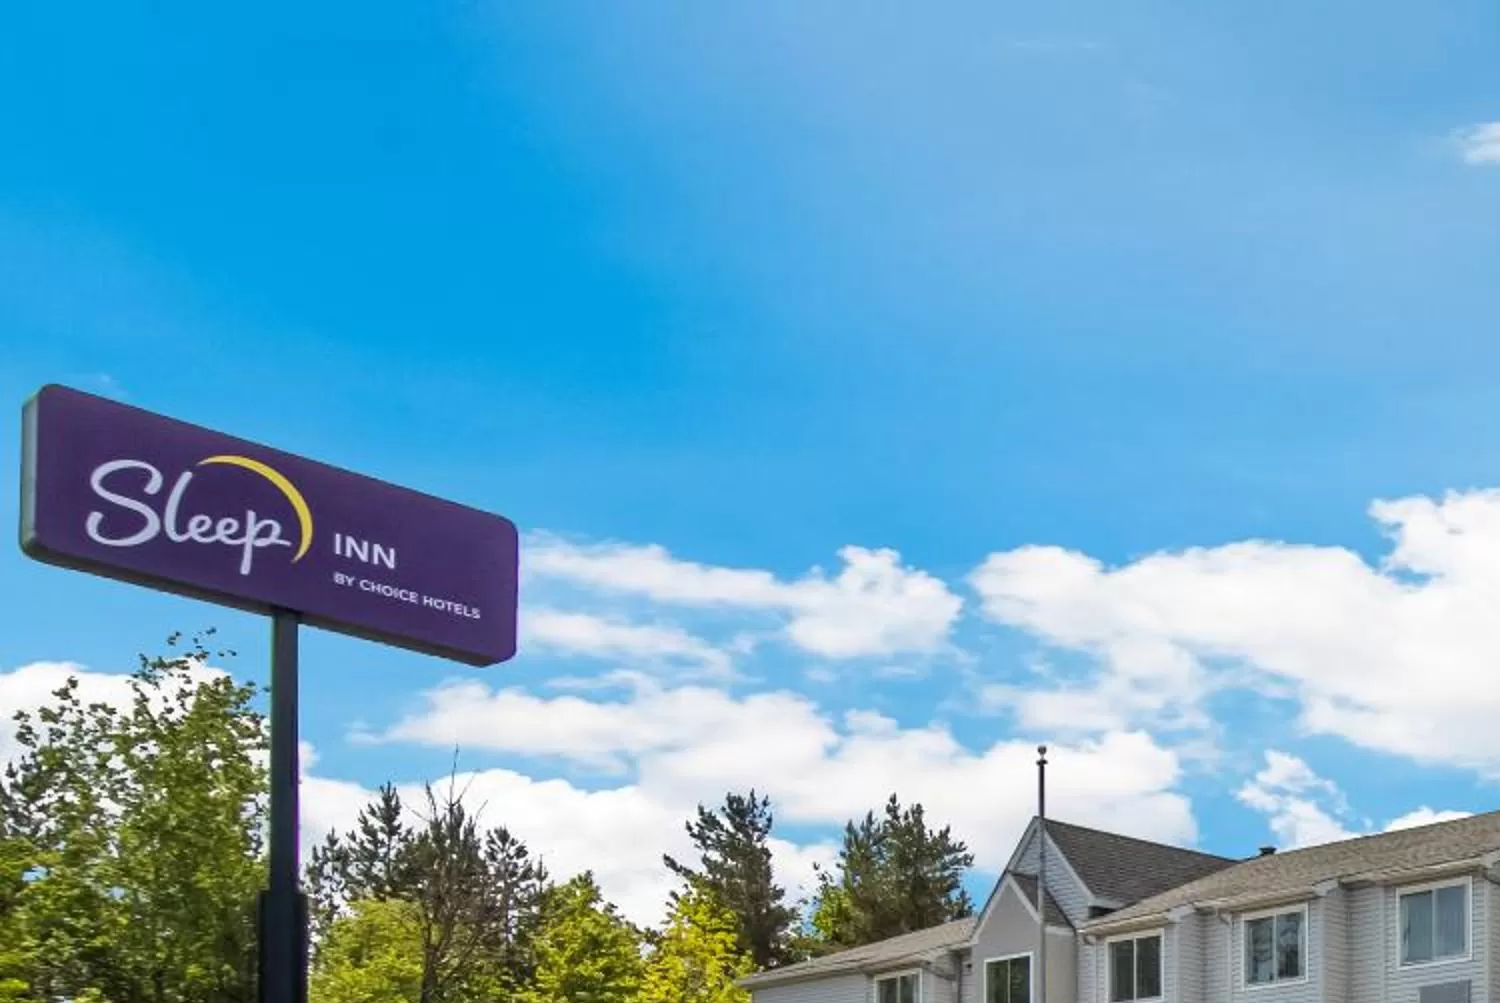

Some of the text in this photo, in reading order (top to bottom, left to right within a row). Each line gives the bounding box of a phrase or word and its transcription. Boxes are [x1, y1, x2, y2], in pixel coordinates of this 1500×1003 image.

[86, 459, 292, 575] Sleep
[334, 532, 396, 570] INN
[333, 572, 481, 619] BY CHOICE HOTELS
